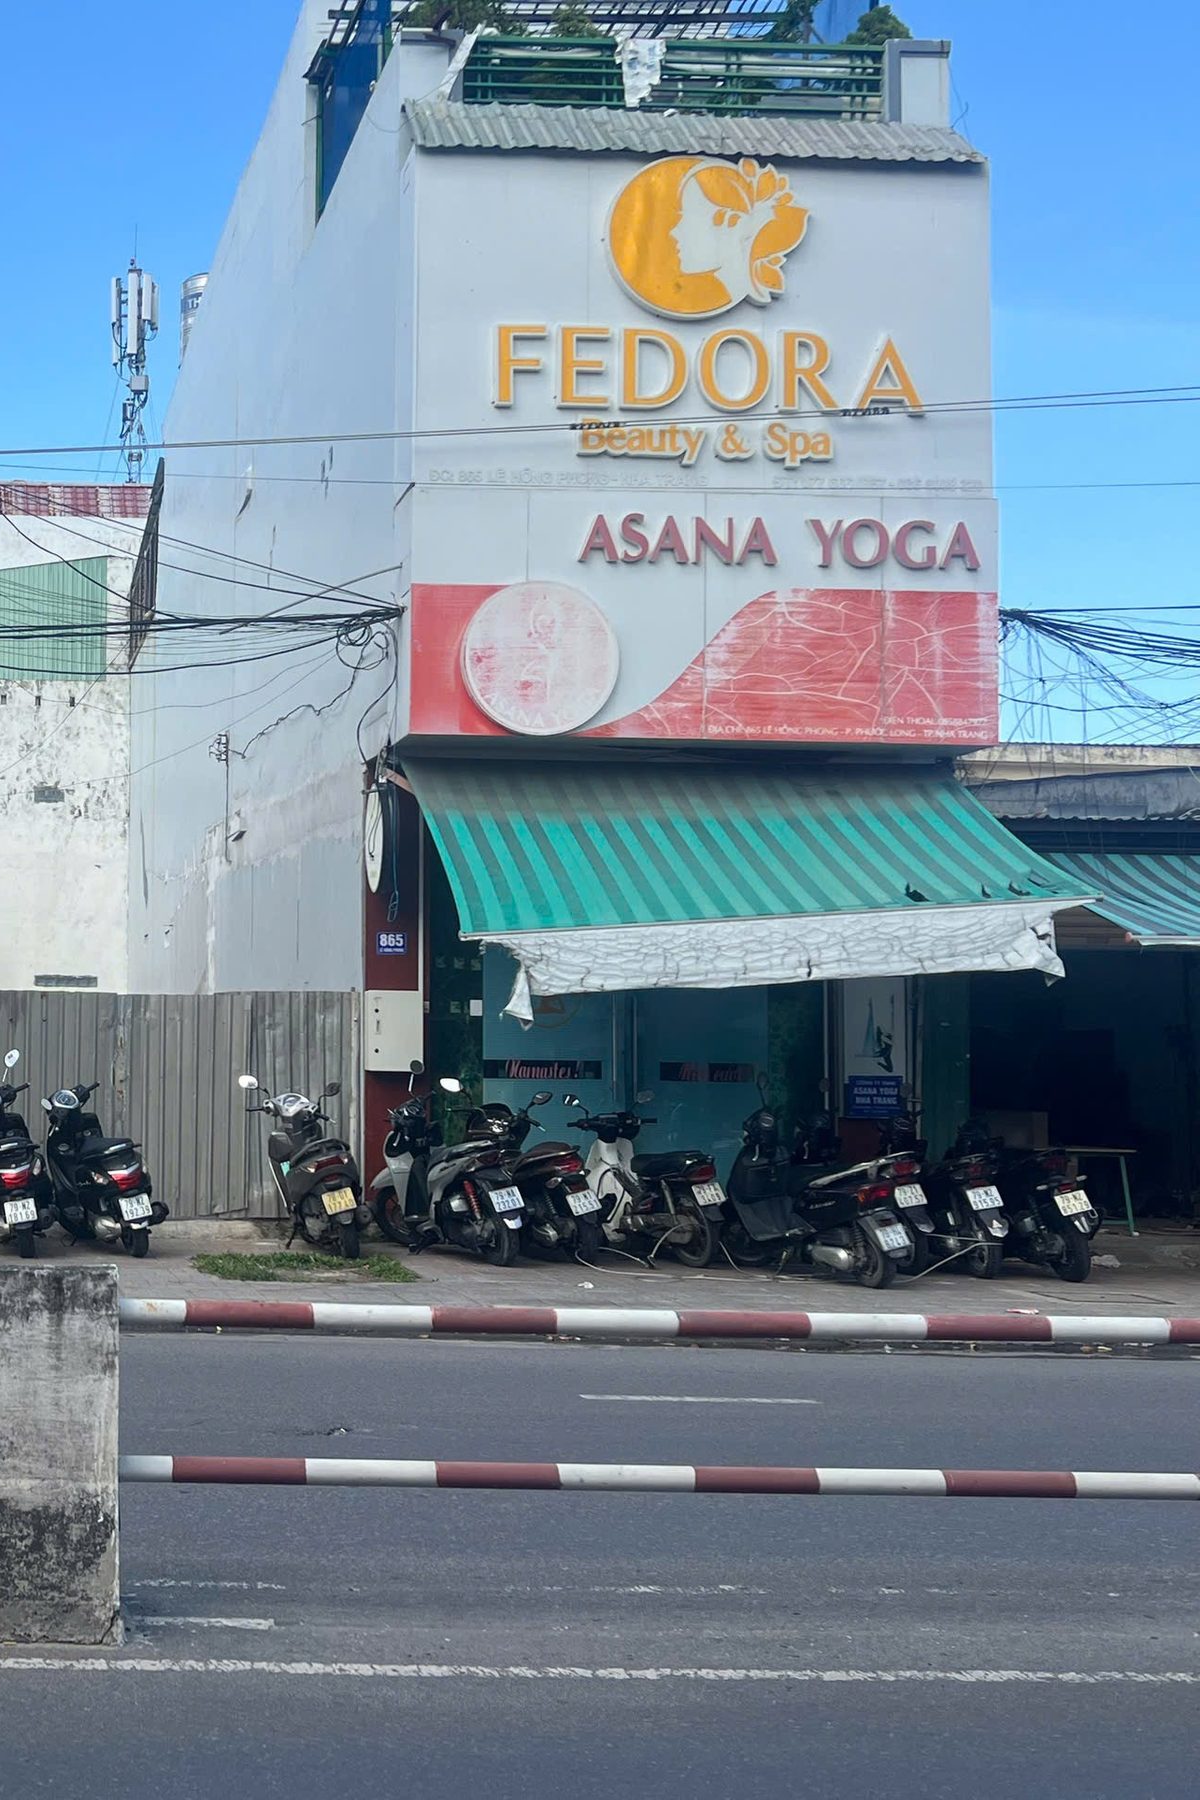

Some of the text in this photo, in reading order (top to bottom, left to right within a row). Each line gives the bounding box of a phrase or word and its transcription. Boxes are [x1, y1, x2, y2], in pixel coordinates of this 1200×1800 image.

[491, 322, 927, 417] FEDORA
[578, 416, 707, 466] Beauty
[764, 420, 834, 470] Spa
[577, 511, 982, 571] ASANA YOGA
[380, 933, 404, 947] 865
